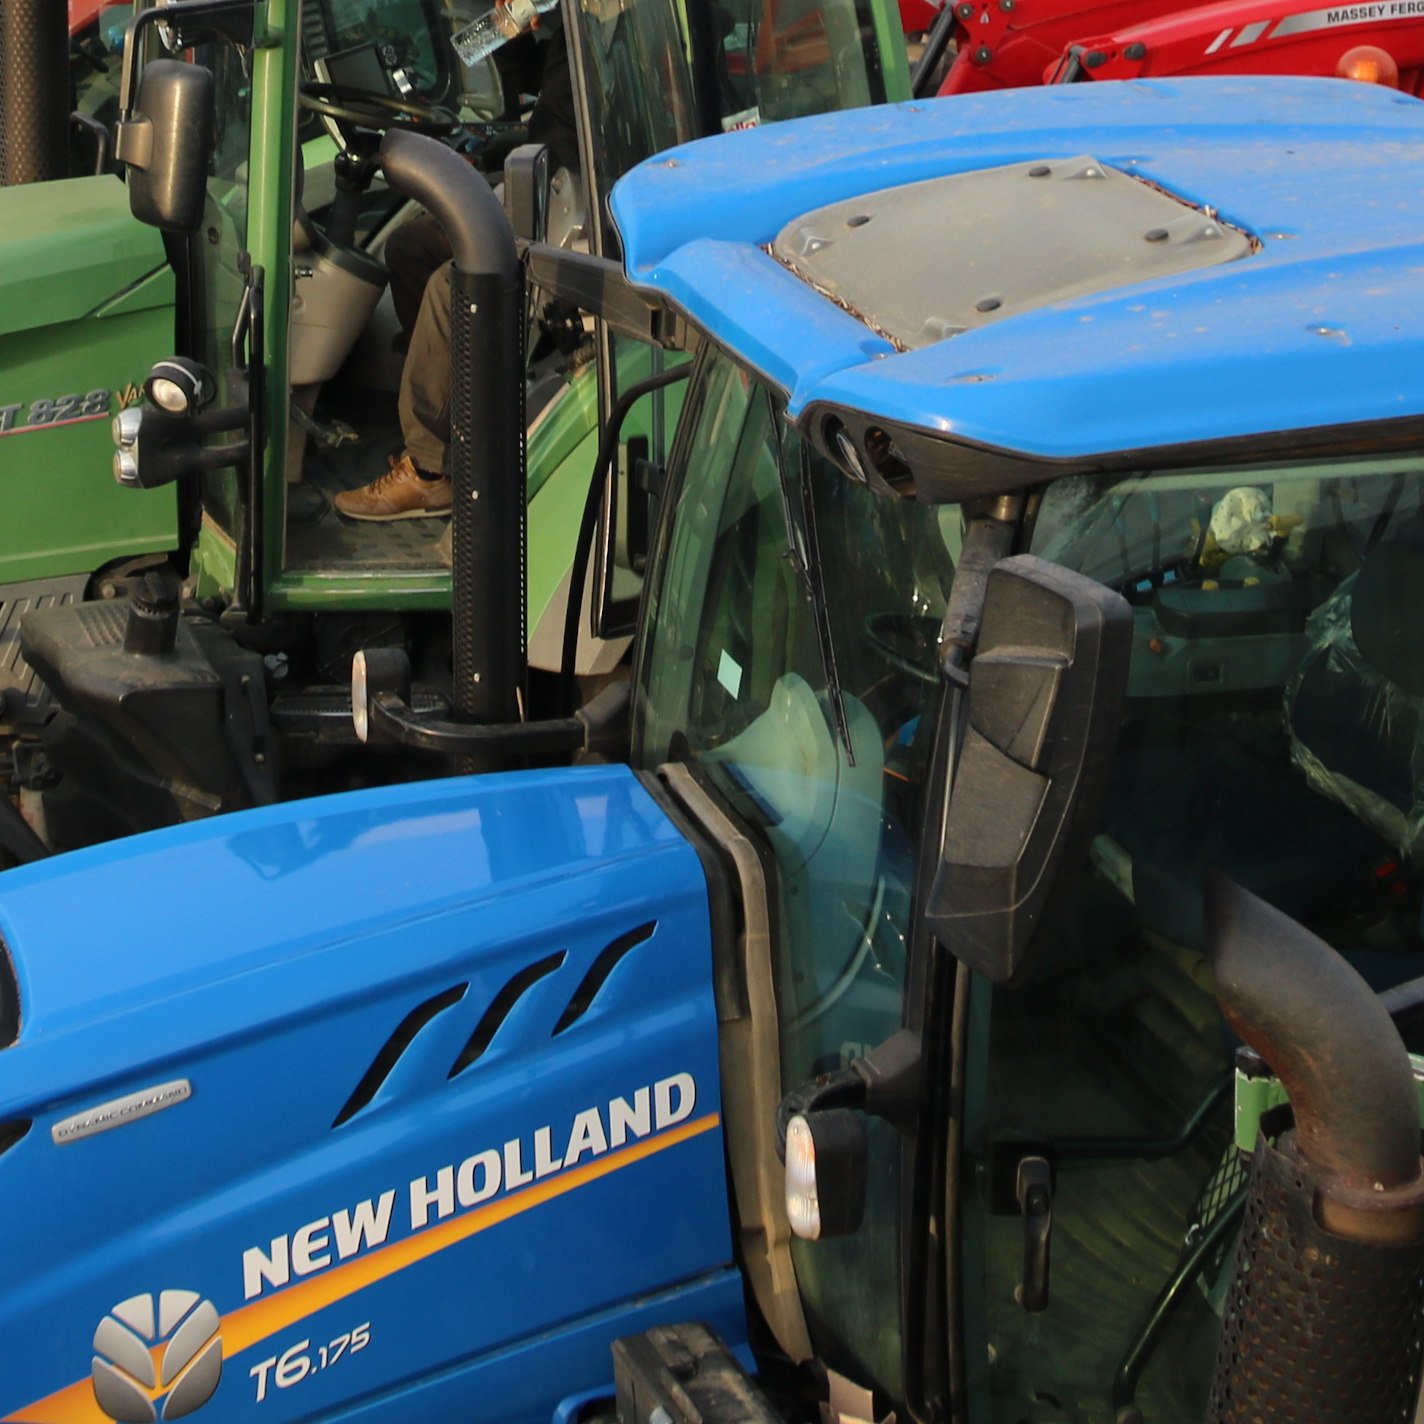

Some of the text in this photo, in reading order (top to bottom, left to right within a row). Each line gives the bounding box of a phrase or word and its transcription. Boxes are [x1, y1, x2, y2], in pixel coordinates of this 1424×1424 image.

[1327, 4, 1386, 24] MASSEY
[27, 388, 110, 426] 828
[58, 1086, 188, 1138] DYNAMIC COMMAND
[242, 1071, 697, 1300] NEW HOLLAND
[248, 1320, 372, 1403] T6.175
